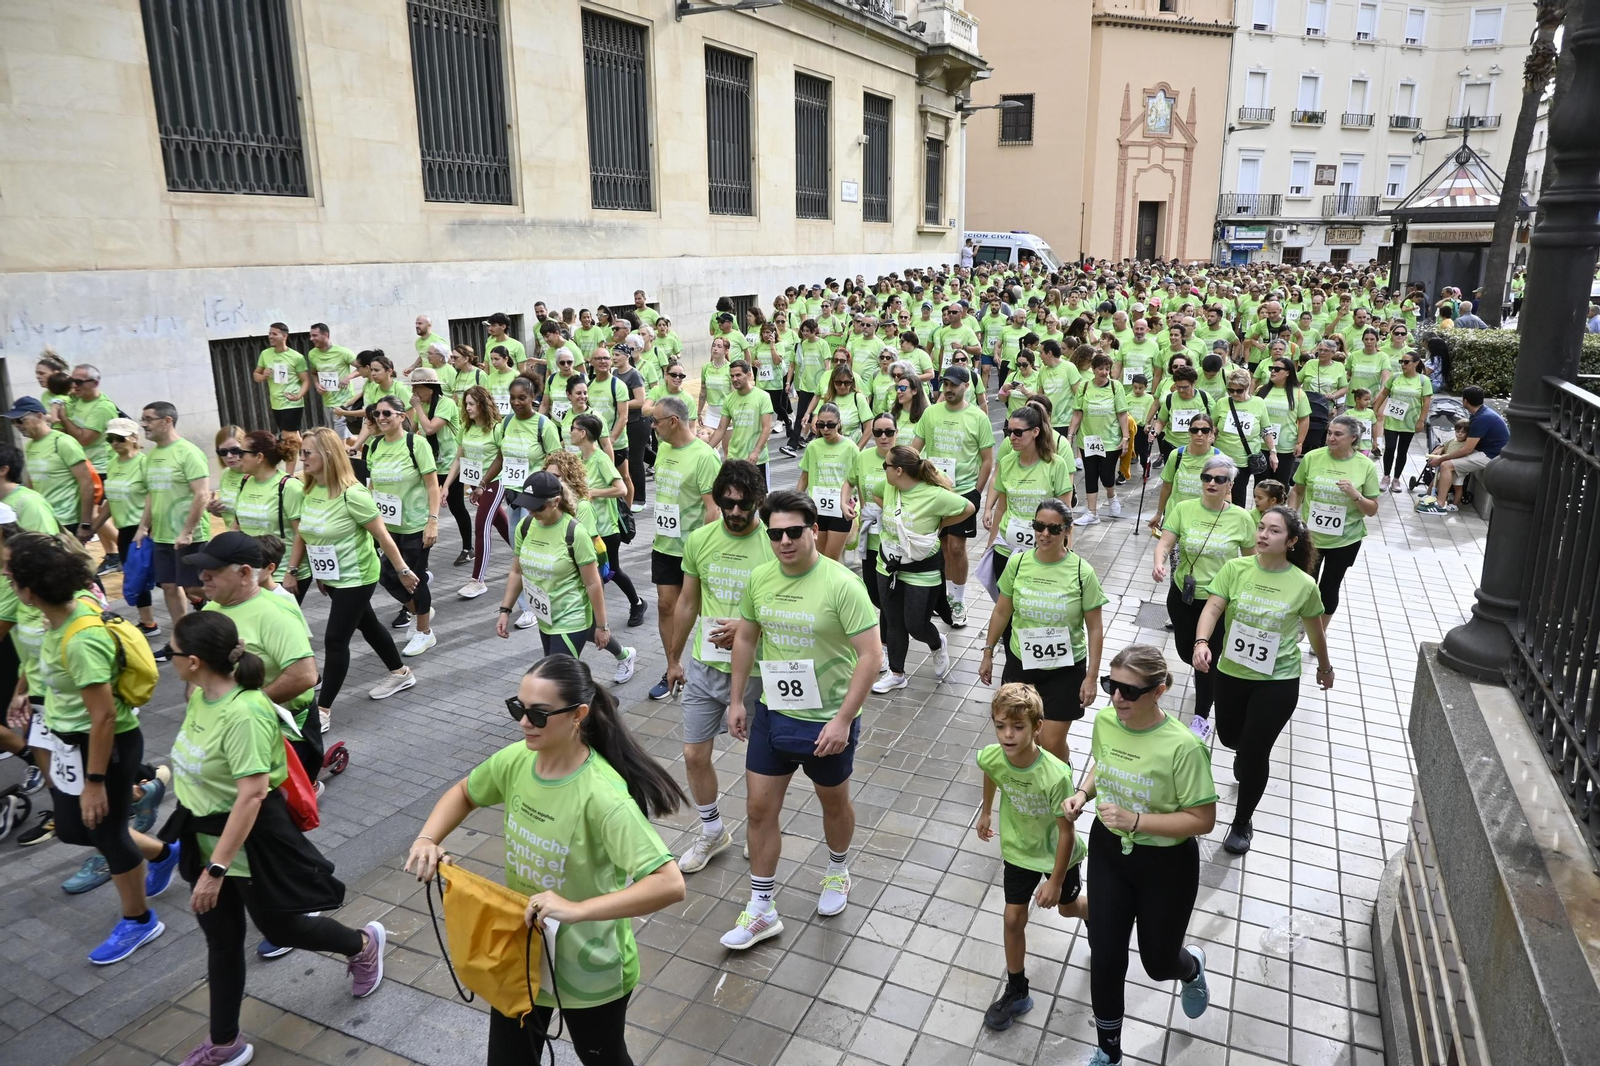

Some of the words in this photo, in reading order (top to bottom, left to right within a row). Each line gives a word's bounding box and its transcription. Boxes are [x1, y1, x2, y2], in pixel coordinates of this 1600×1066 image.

[1459, 231, 1492, 240] FERNANDO
[463, 468, 480, 480] 450
[820, 498, 834, 509] 95
[1016, 532, 1036, 547] 92
[709, 563, 721, 573] En
[723, 566, 752, 578] march
[708, 576, 744, 589] contra
[1020, 598, 1054, 610] contra
[1056, 601, 1068, 611] el
[1240, 592, 1252, 601] En
[1254, 595, 1291, 610] marcha
[760, 605, 773, 617] En
[775, 609, 816, 622] marcha
[1020, 607, 1068, 622] cáncer
[1237, 602, 1274, 617] contra
[760, 620, 800, 633] contra
[801, 624, 815, 635] el
[1234, 638, 1269, 662] 913
[777, 679, 804, 697] 98
[1096, 760, 1107, 772] En
[1109, 765, 1154, 787] marcha
[1094, 776, 1133, 798] contra
[1136, 786, 1151, 802] el
[507, 813, 518, 833] En
[519, 826, 569, 856] marcha
[506, 834, 545, 868] contra
[548, 858, 566, 874] el
